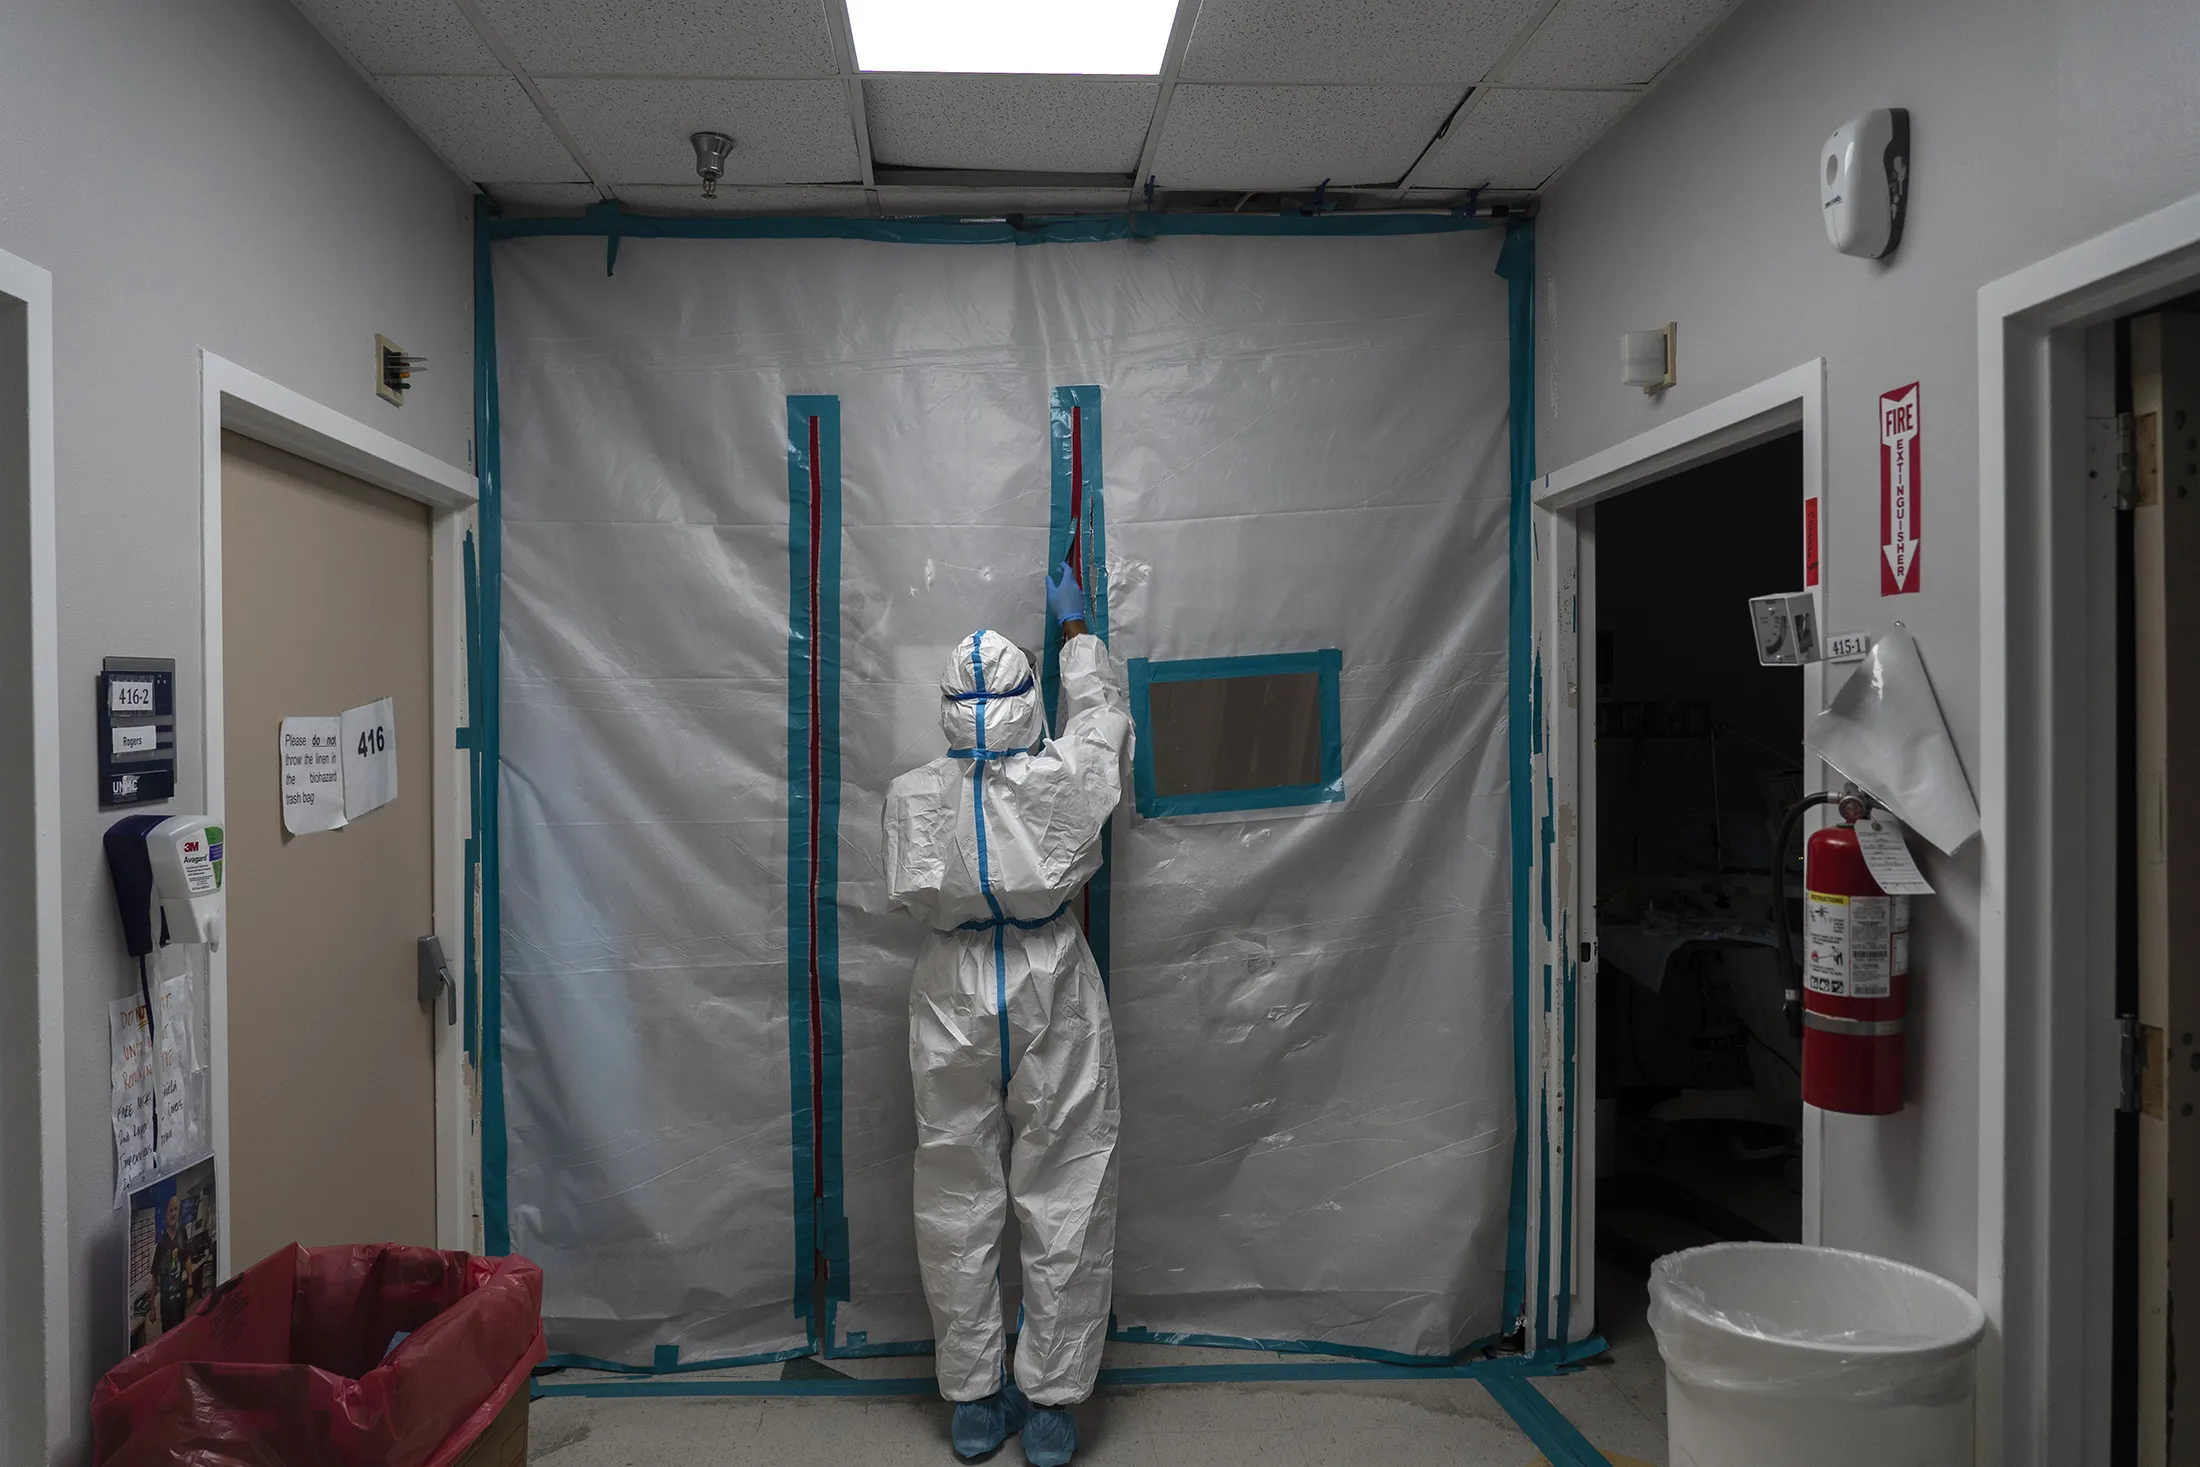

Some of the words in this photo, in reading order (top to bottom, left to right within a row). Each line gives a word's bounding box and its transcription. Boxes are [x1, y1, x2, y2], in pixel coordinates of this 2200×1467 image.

[1886, 403, 1914, 437] FIRE
[1896, 439, 1905, 577] EXTINGUISHER
[1832, 638, 1862, 654] 415-1
[122, 735, 143, 749] Rogers
[285, 733, 307, 747] Please
[311, 734, 321, 747] do
[326, 734, 337, 747] not
[357, 725, 385, 758] 416
[285, 753, 303, 766] throw
[304, 752, 314, 765] the
[315, 752, 330, 765] linen
[331, 752, 337, 764] in
[285, 772, 296, 786] the
[309, 771, 338, 784] biohazard
[286, 792, 301, 805] trash
[302, 791, 315, 805] bag
[183, 841, 200, 853] 3M
[183, 854, 208, 865] Avagard
[120, 1011, 134, 1030] DO
